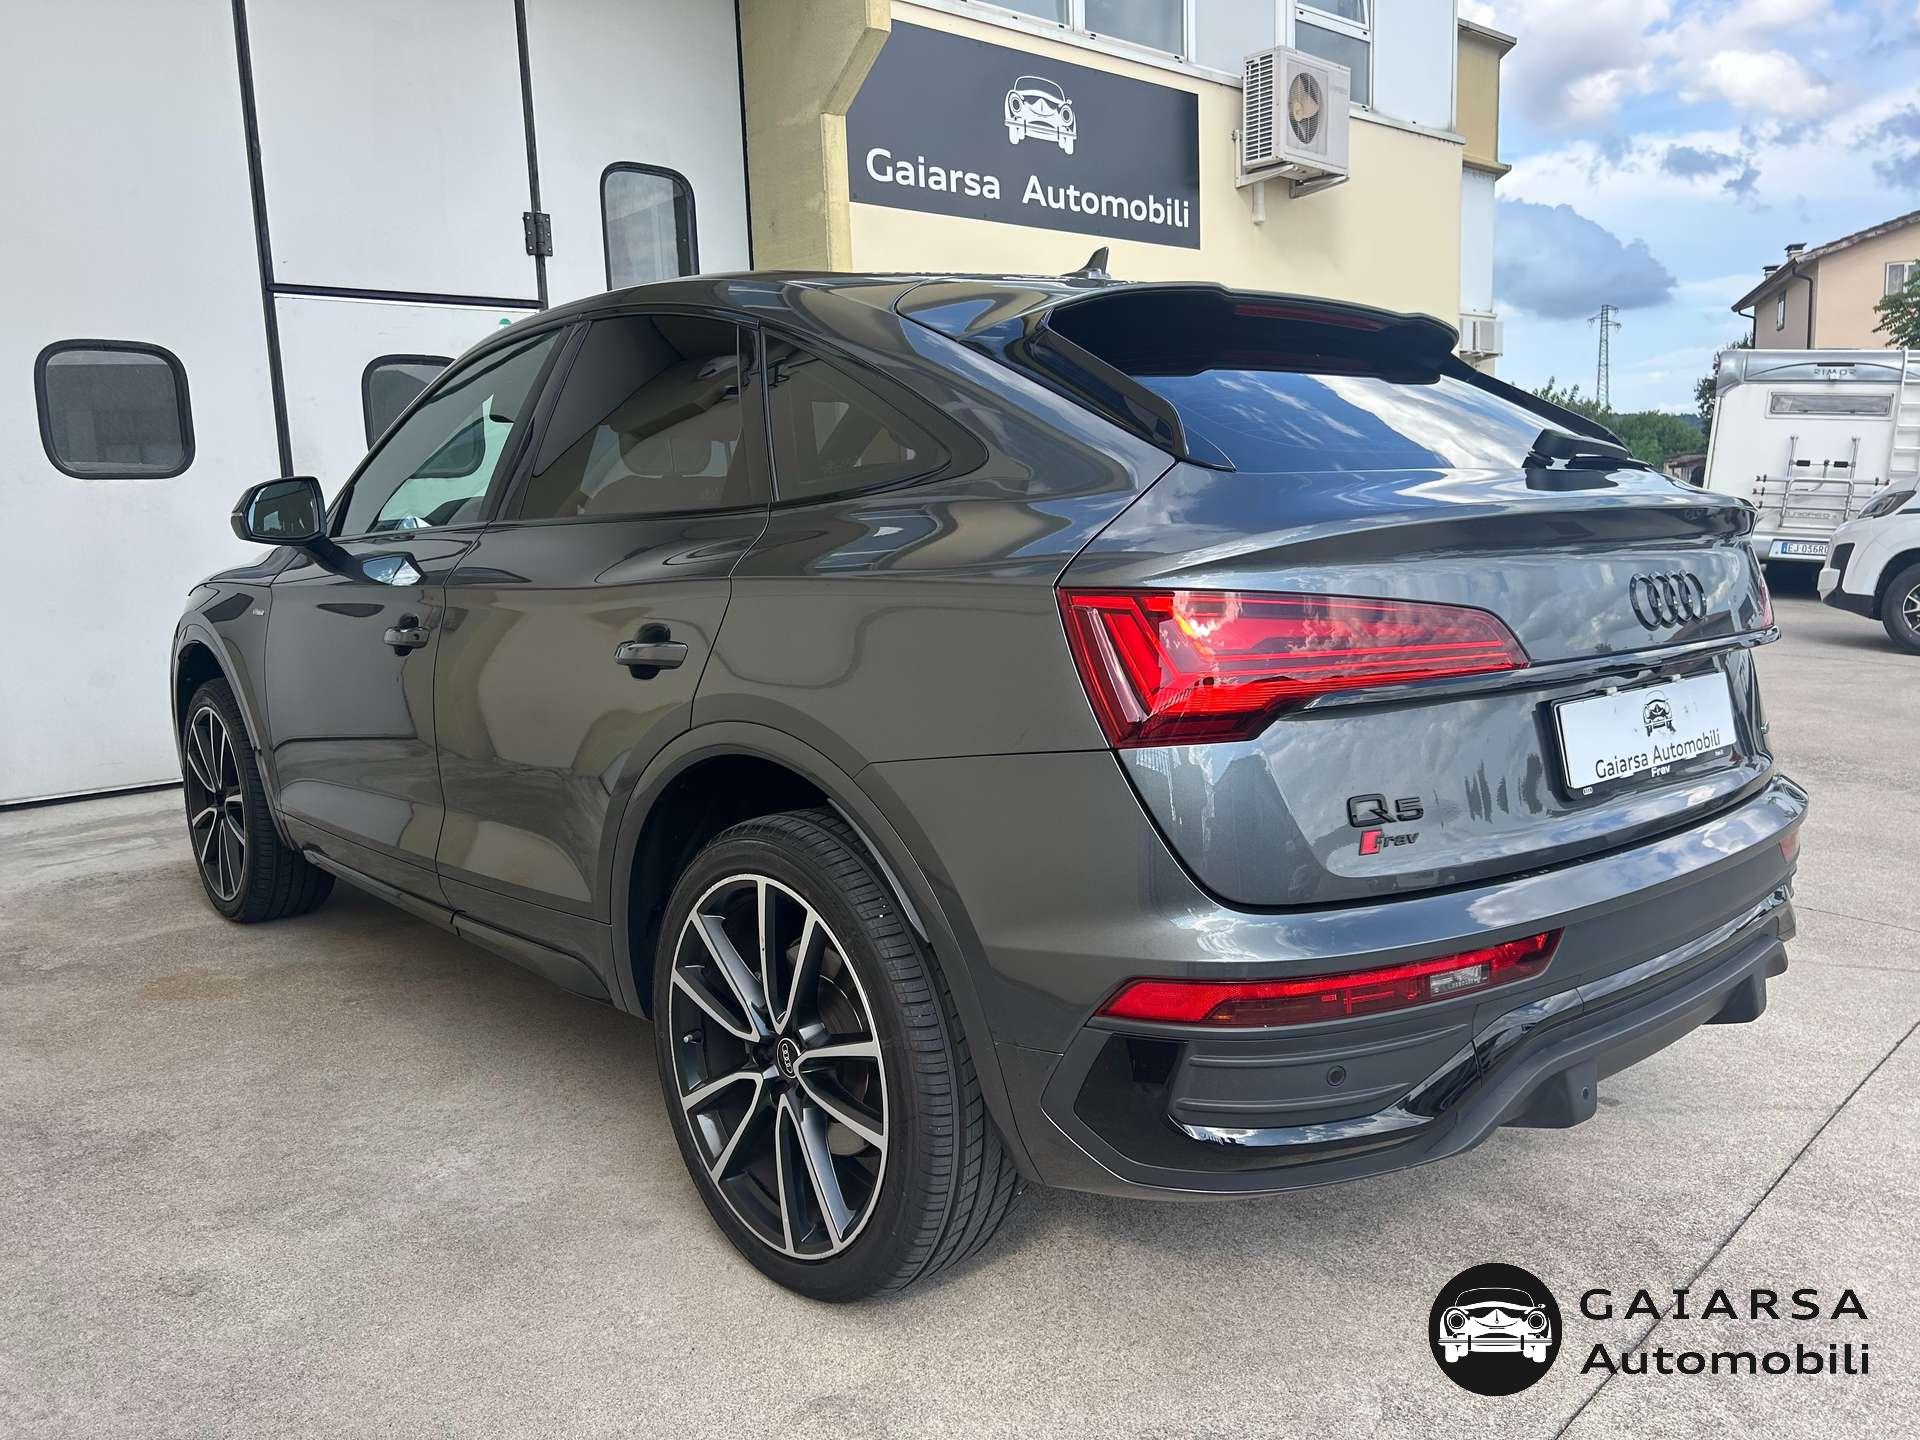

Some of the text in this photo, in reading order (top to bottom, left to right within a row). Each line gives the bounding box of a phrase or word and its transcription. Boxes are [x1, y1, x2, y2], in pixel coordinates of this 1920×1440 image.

[866, 148, 1190, 228] Gaiarsa Automobili
[1595, 728, 1721, 779] Gaiarsa Automobili
[1651, 764, 1671, 778] Frav
[1346, 793, 1424, 828] Q5
